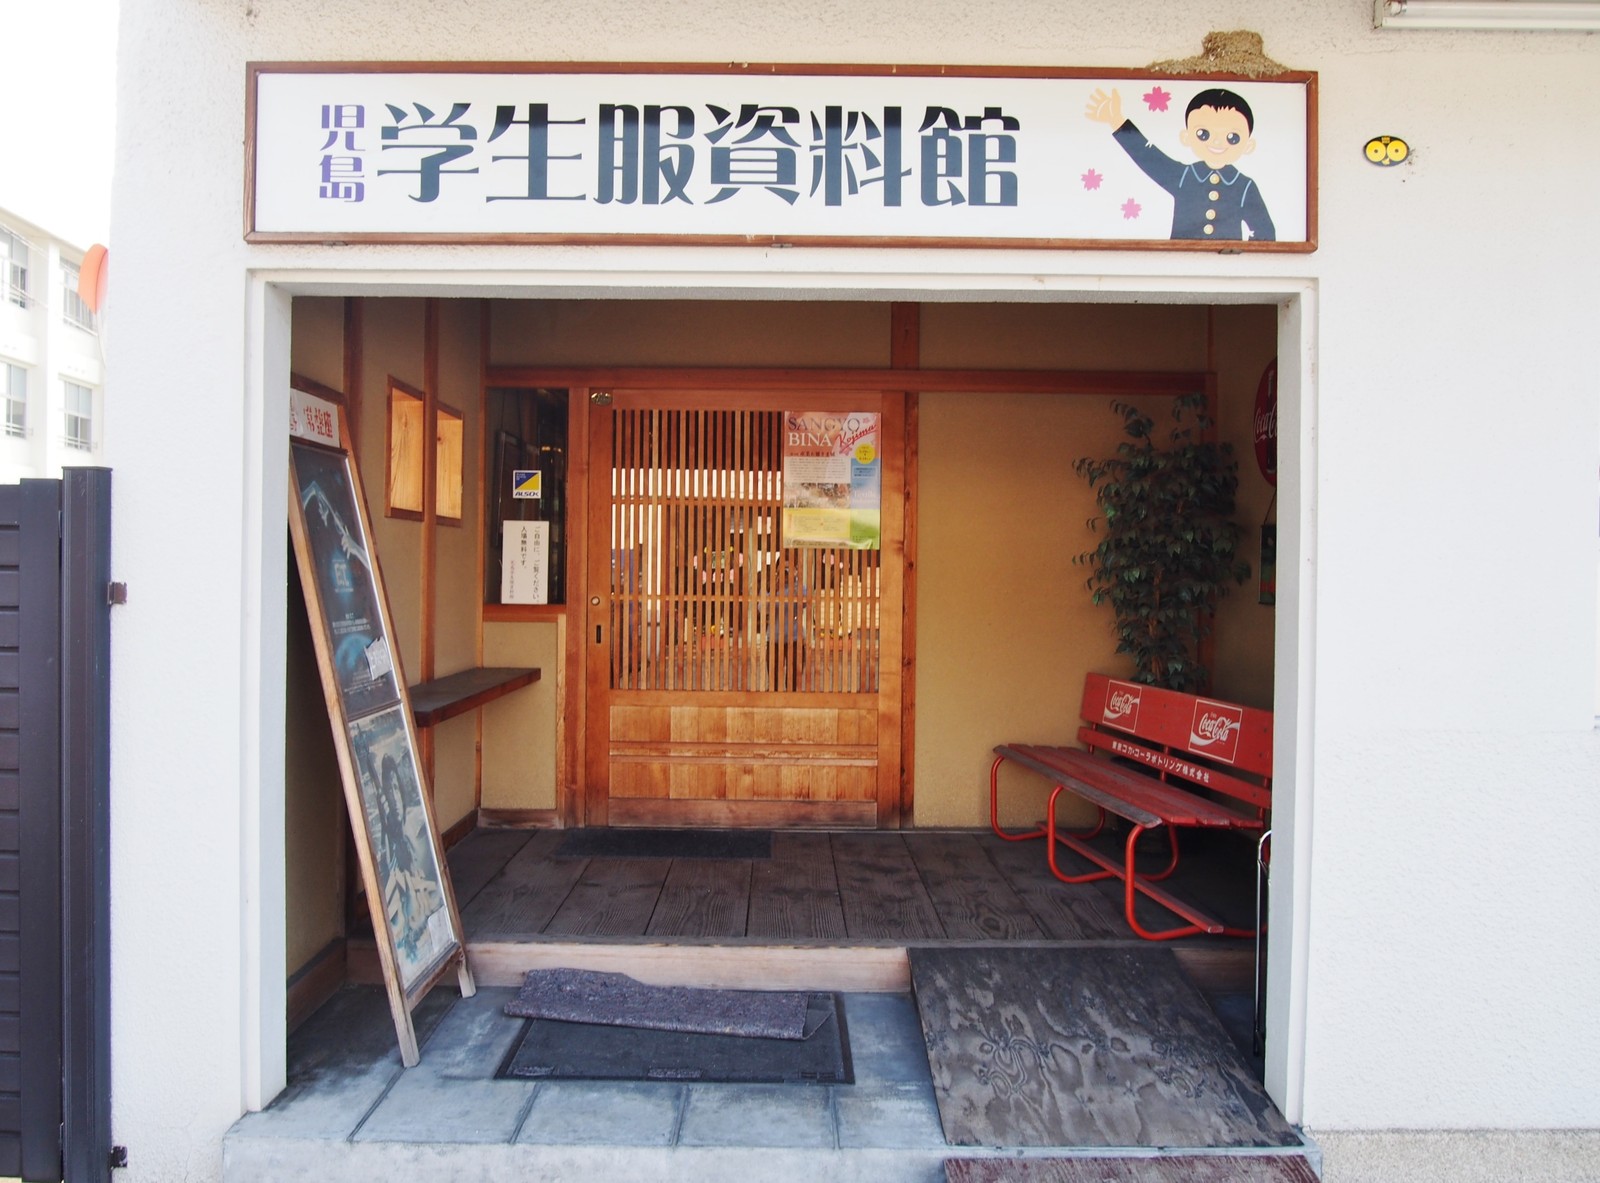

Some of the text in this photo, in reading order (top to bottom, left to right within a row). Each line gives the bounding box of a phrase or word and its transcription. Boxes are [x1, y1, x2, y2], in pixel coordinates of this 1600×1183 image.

[319, 104, 366, 204] 児島
[377, 102, 1021, 207] 学生服資料館
[788, 417, 860, 431] SANGYO
[789, 432, 832, 446] BINA
[1199, 713, 1231, 742] Coca-Cola
